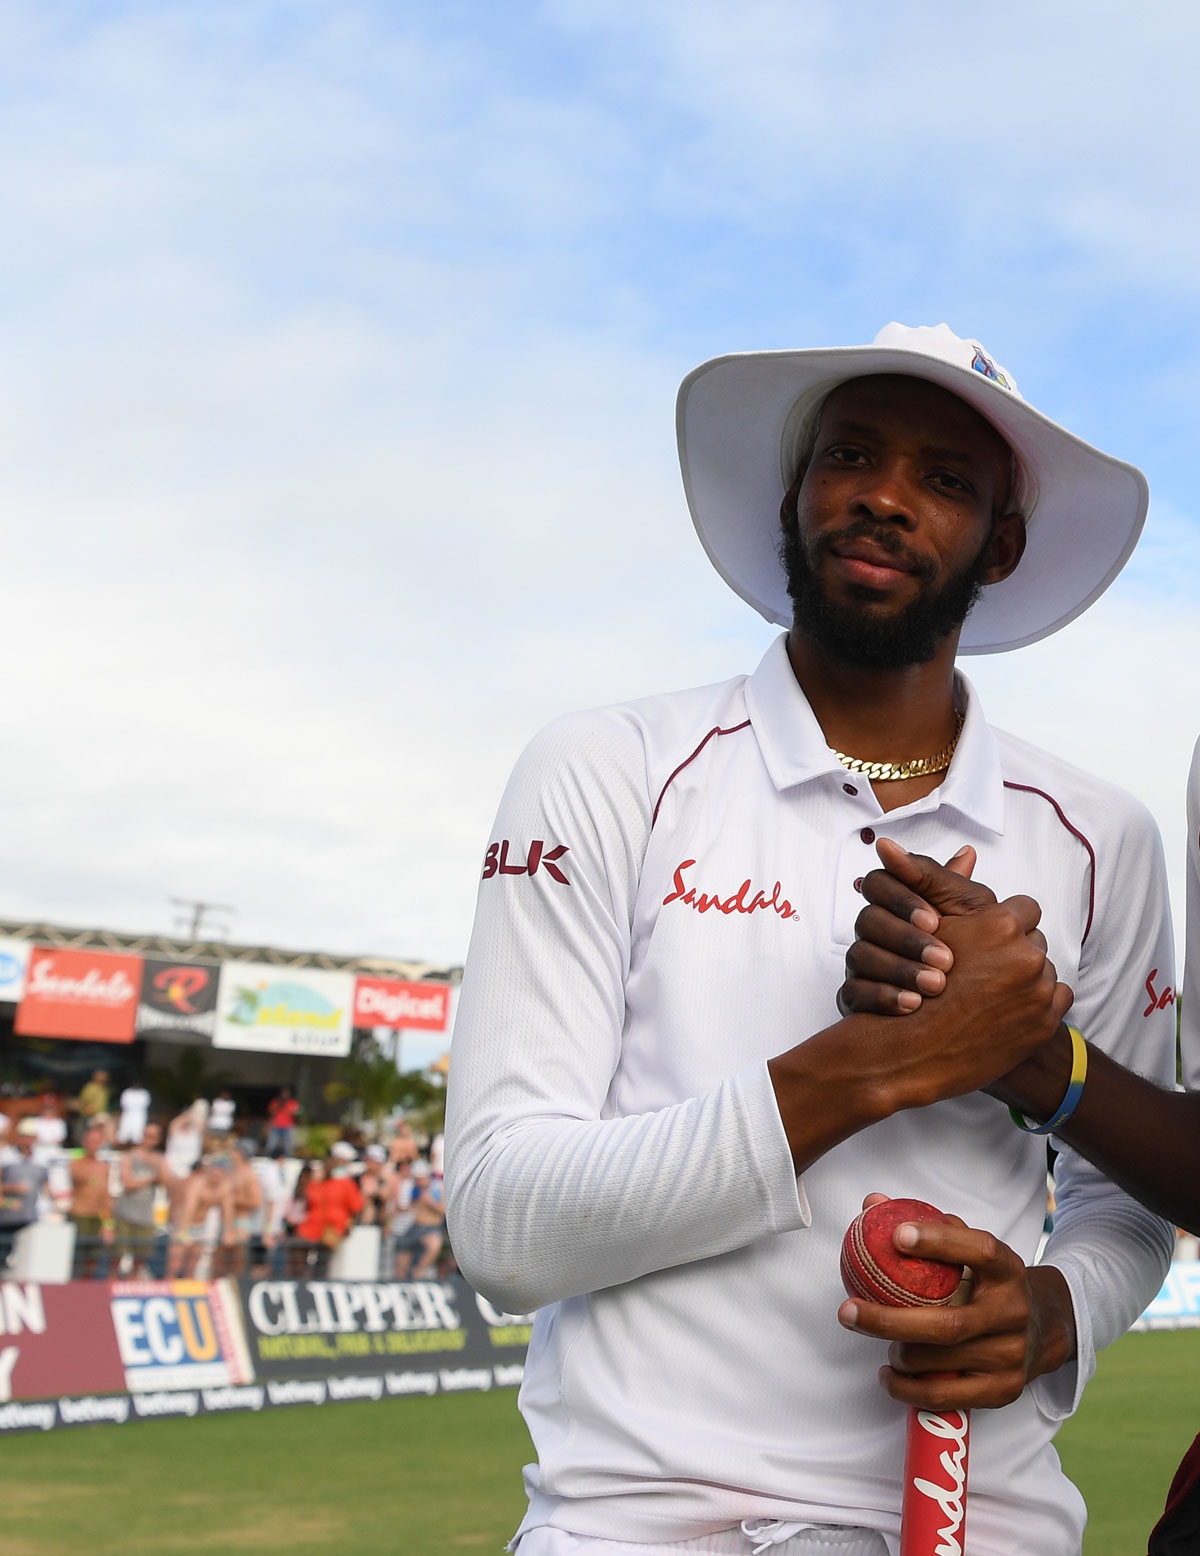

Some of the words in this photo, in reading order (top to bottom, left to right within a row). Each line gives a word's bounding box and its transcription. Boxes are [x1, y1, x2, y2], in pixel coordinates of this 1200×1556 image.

[482, 839, 571, 886] BLK
[663, 858, 796, 918] Sandals
[357, 986, 444, 1022] Digicel
[110, 1297, 218, 1366] ECU
[249, 1280, 461, 1336] CLIPPER
